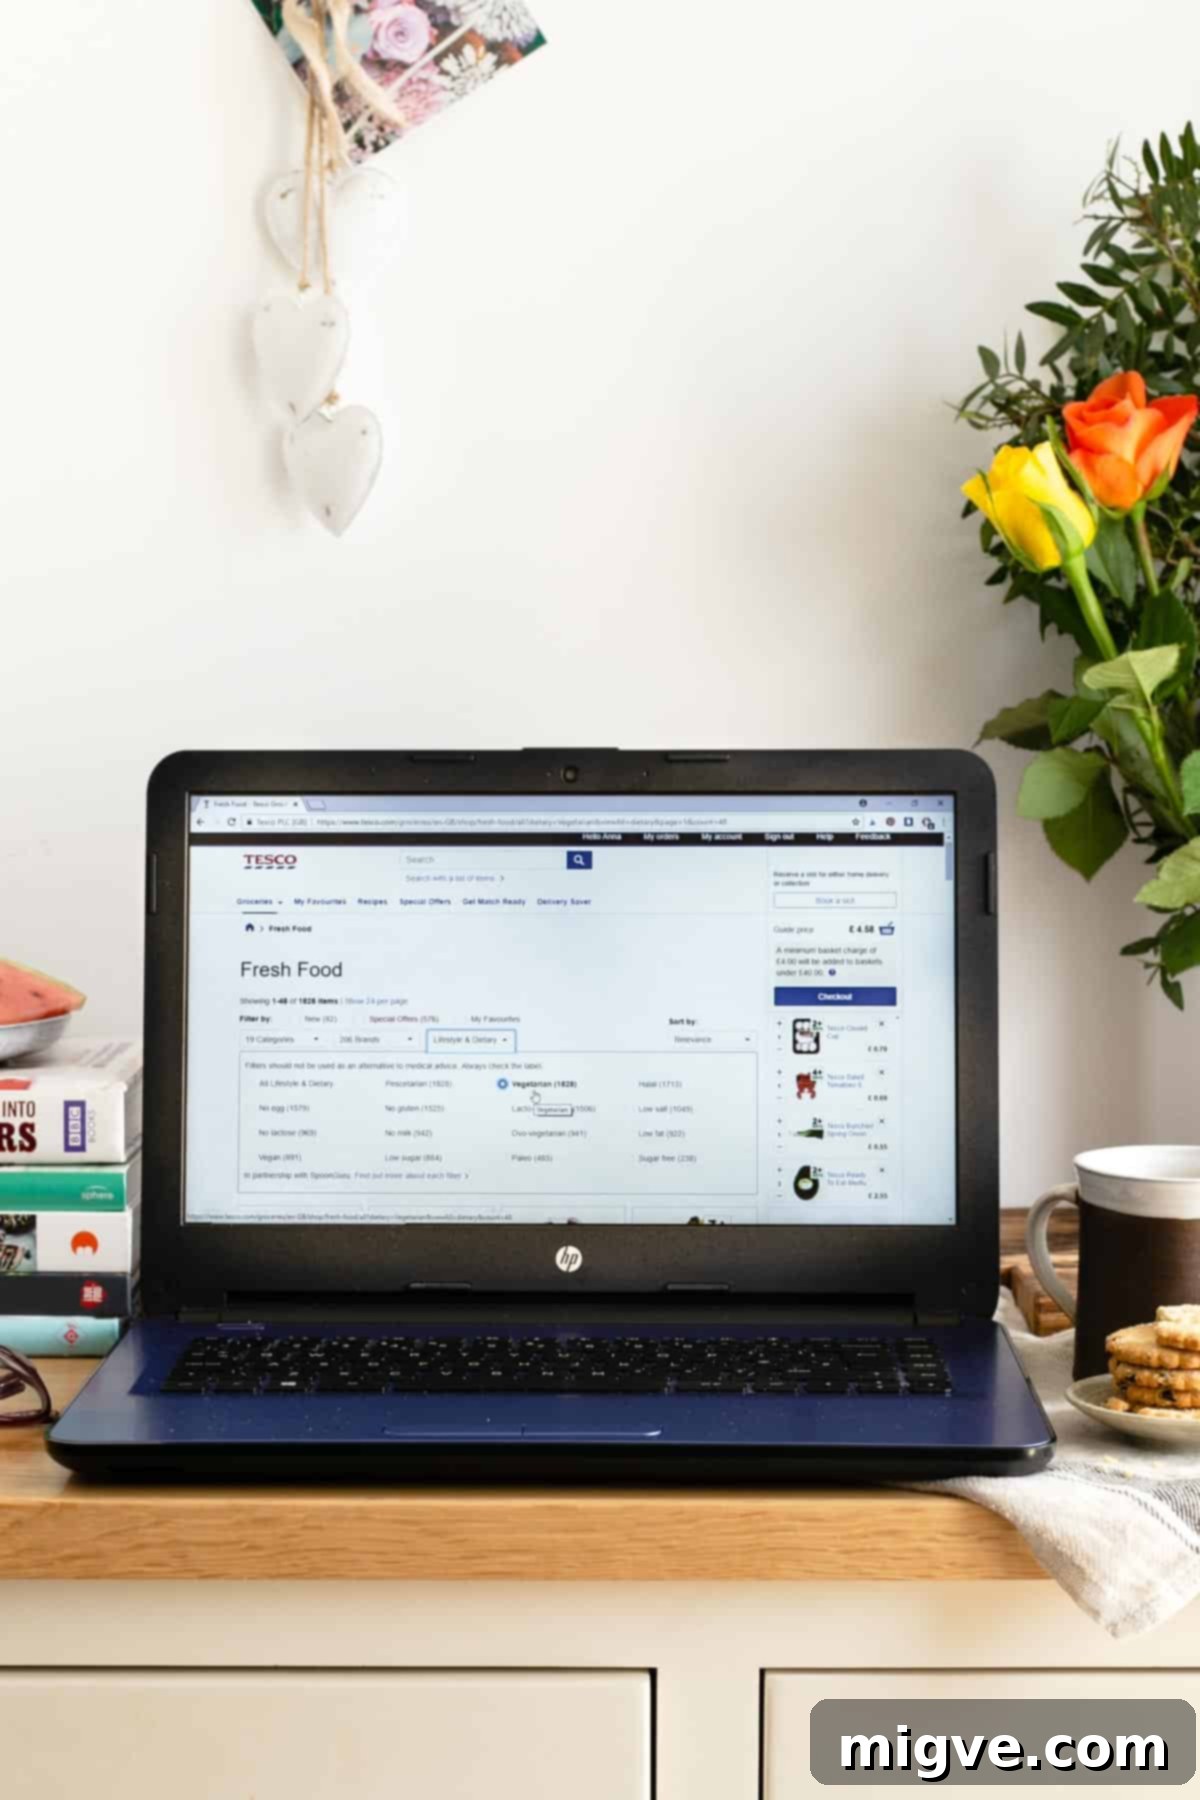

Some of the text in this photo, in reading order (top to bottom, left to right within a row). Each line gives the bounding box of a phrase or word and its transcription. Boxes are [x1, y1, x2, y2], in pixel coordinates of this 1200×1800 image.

[643, 833, 680, 842] My orders
[701, 833, 743, 842] My account
[764, 833, 795, 842] Sign out
[816, 833, 834, 842] Help
[855, 833, 892, 841] Feedback
[243, 854, 297, 866] TESCO
[405, 855, 434, 864] Search
[294, 898, 305, 907] My
[358, 898, 388, 906] Recipes
[399, 898, 427, 907] Special
[502, 898, 526, 907] Ready
[537, 898, 568, 907] Delivery
[268, 924, 312, 932] Fresh Food
[796, 926, 814, 935] price
[848, 925, 875, 934] £ 4.58
[240, 961, 343, 978] Fresh Food
[817, 992, 853, 1001] Checkout
[240, 998, 270, 1006] Showing
[260, 1015, 271, 1024] by:
[304, 1015, 321, 1023] New
[369, 1015, 396, 1024] Special
[471, 1015, 482, 1024] My
[686, 1018, 697, 1026] by:
[256, 1036, 295, 1044] Categories
[433, 1036, 461, 1044] Lifestyle
[472, 1036, 497, 1044] Dietary
[512, 1080, 577, 1089] Vegetarian (1828)
[2, 1100, 36, 1118] INTO
[68, 1105, 81, 1145] BBC
[258, 1154, 281, 1162] Vegan
[639, 1153, 660, 1163] Sugar
[661, 1153, 676, 1161] free
[81, 1191, 114, 1202] sphere
